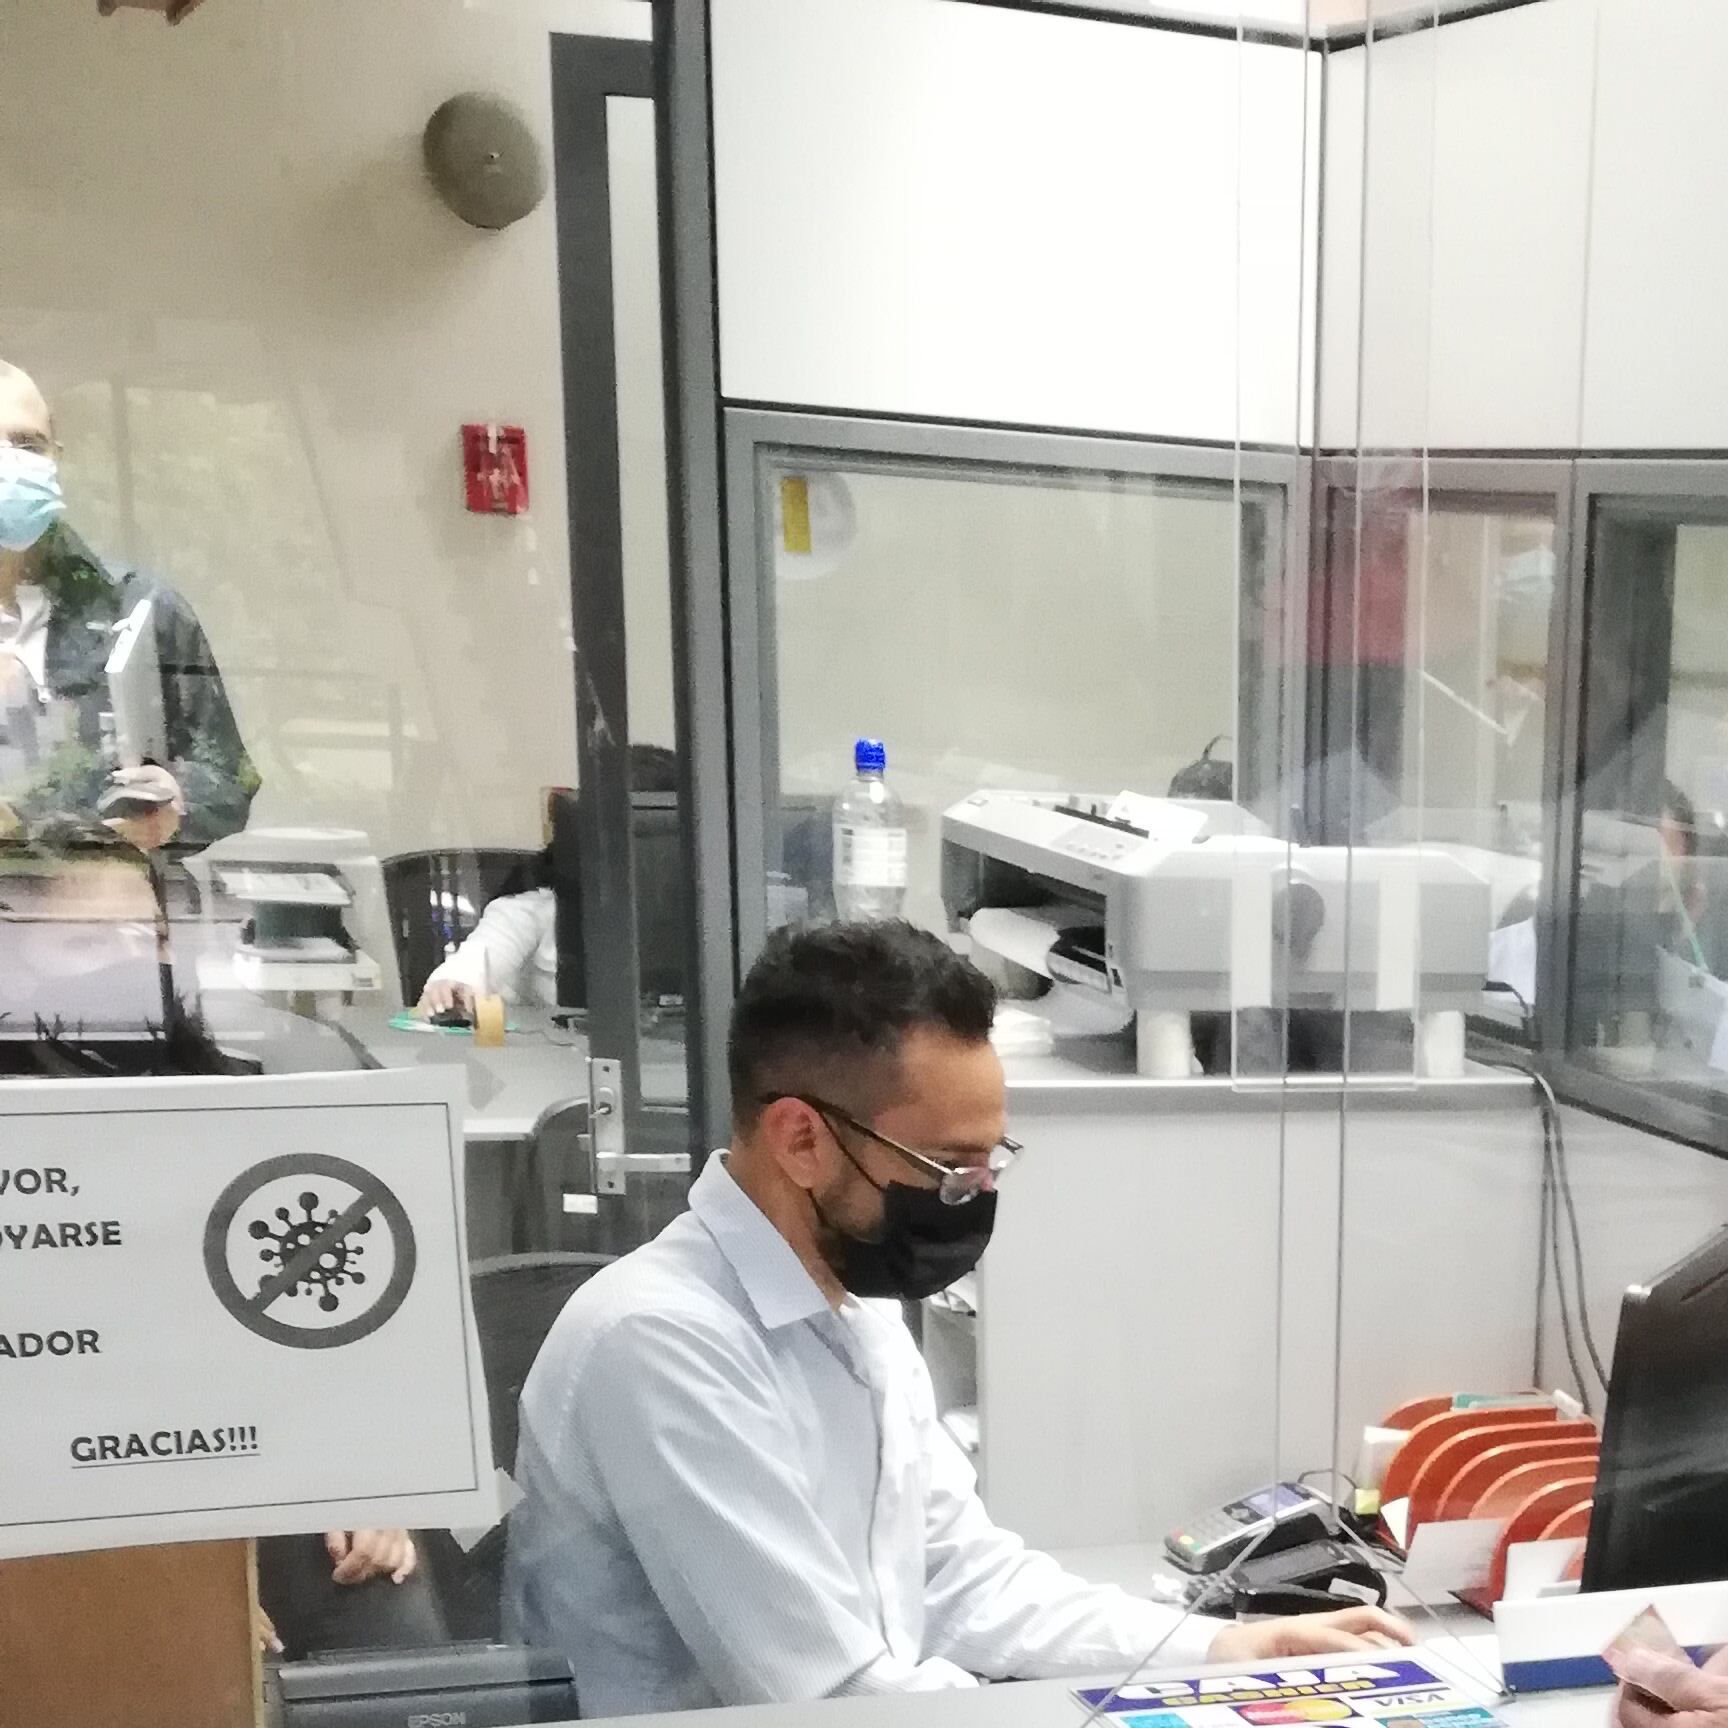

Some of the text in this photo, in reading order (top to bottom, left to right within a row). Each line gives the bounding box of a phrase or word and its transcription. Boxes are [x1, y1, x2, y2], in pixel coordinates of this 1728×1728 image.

[0, 1221, 122, 1250] YARSE
[70, 1425, 259, 1464] GRACIAS!!!
[1116, 1664, 1401, 1700] CAJA
[407, 1712, 467, 1728] EPSON
